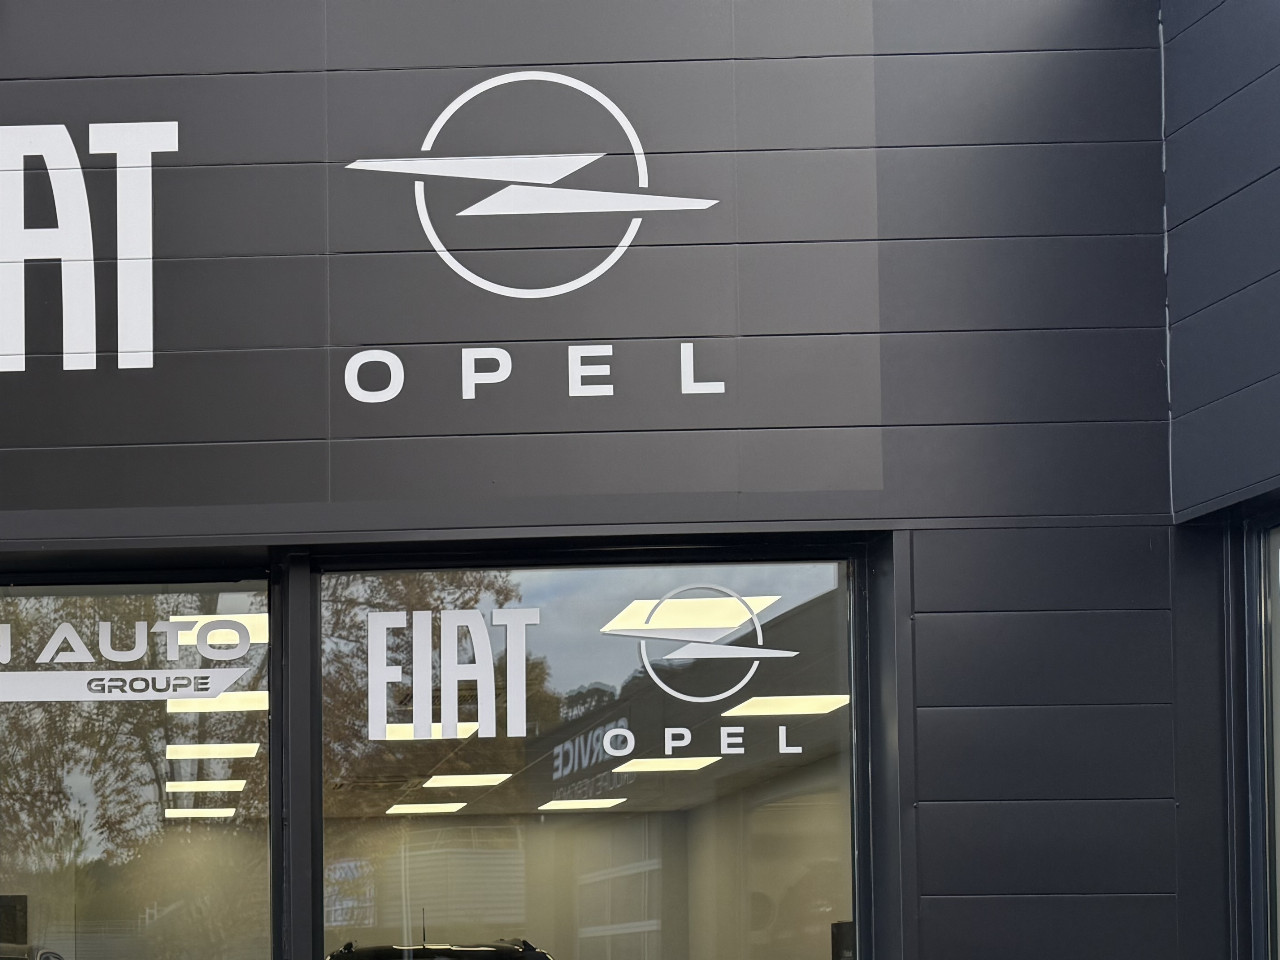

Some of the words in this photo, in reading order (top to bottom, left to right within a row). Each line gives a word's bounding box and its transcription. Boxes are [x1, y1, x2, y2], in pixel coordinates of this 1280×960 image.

[344, 343, 726, 403] OPEL
[35, 620, 250, 663] AUTO
[86, 676, 210, 693] GROUPE
[368, 608, 540, 740] FIAT
[602, 726, 803, 757] OPEL
